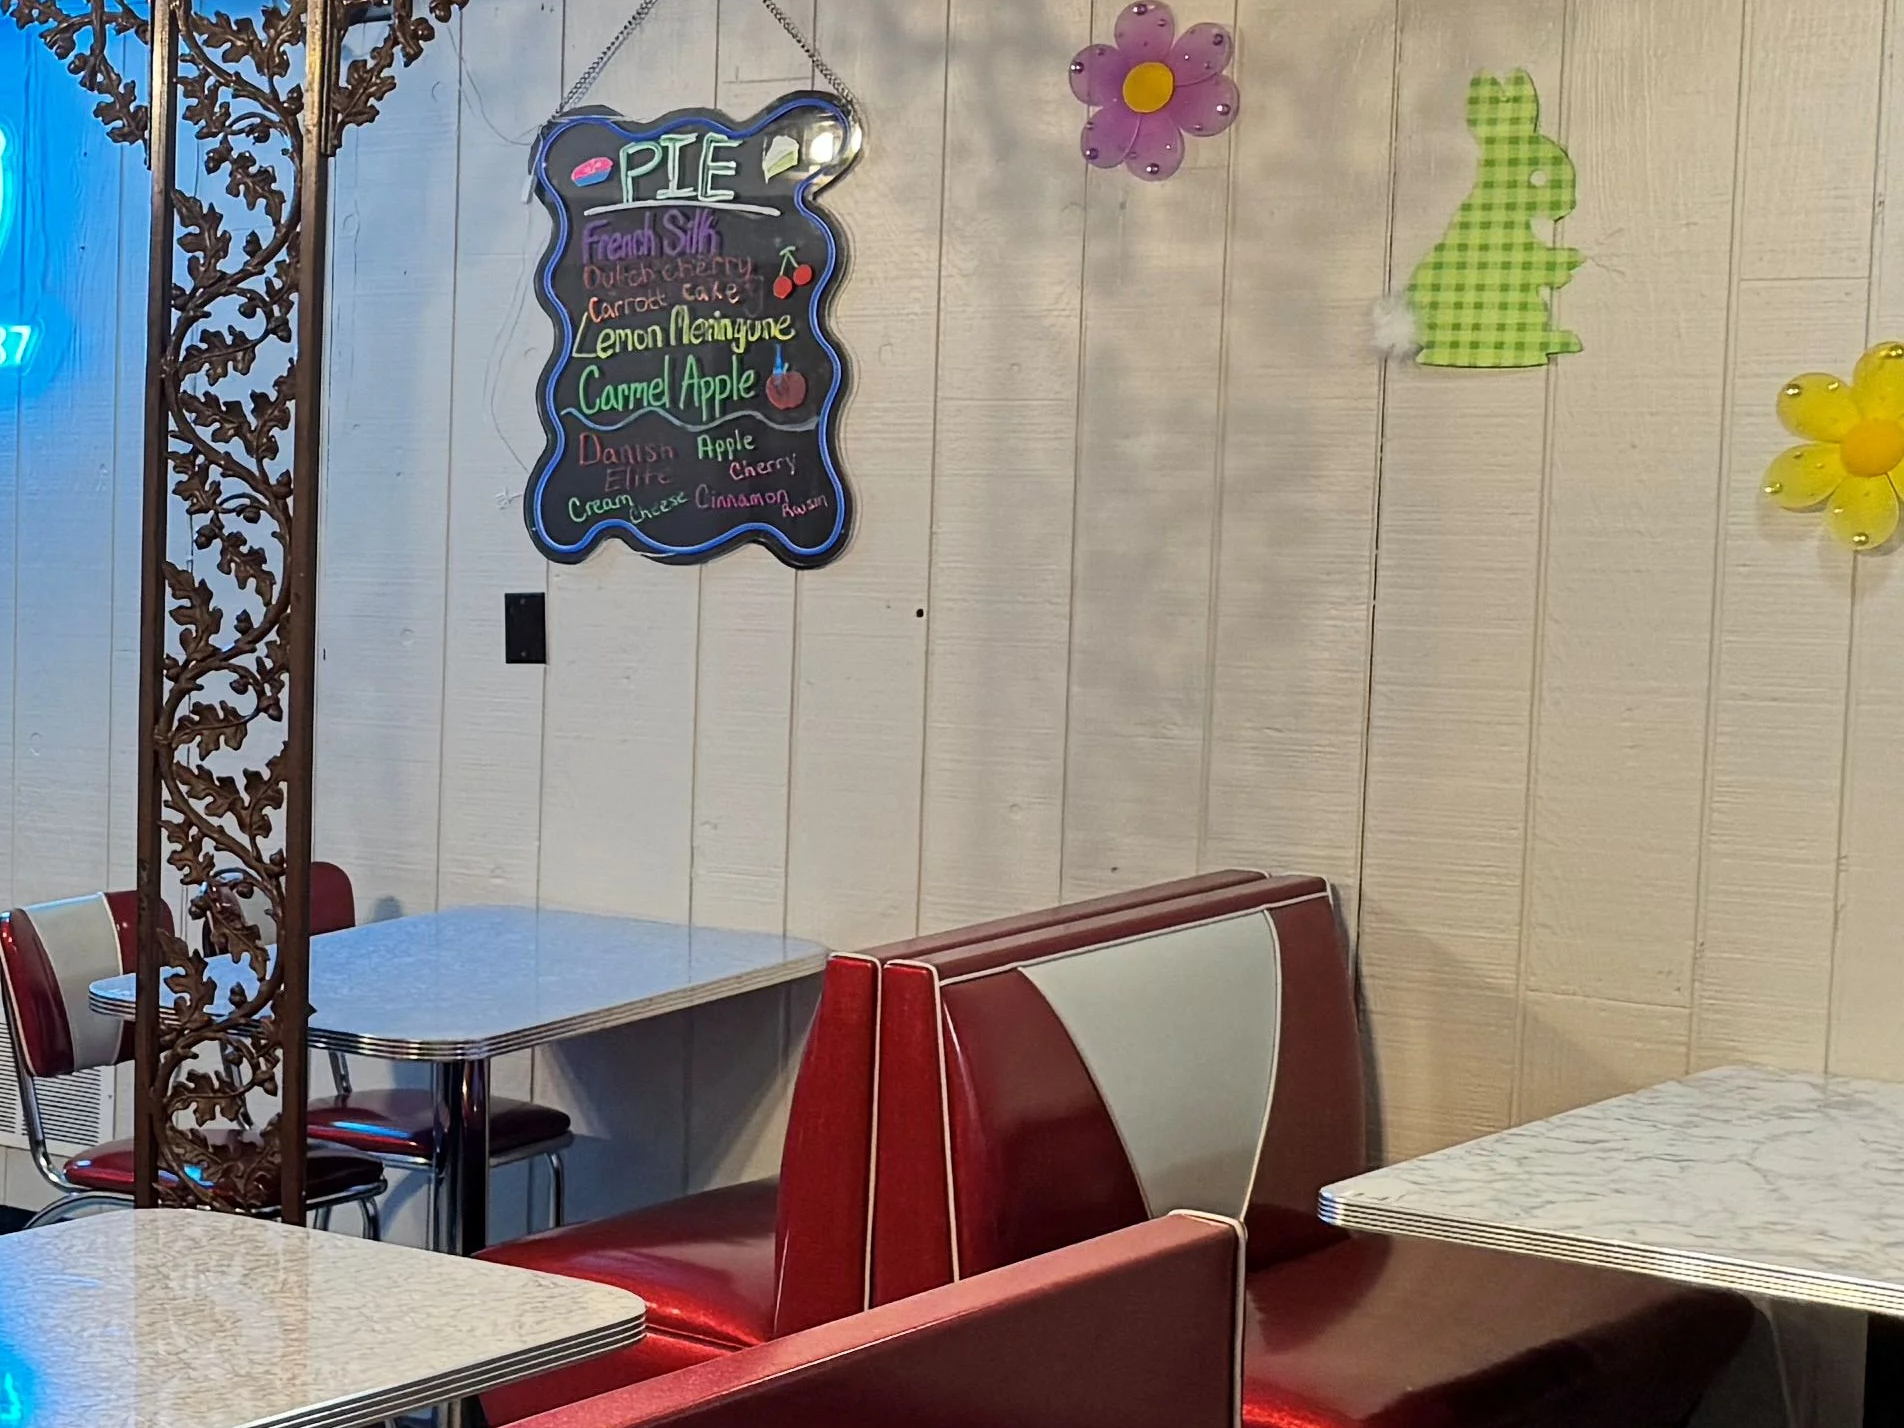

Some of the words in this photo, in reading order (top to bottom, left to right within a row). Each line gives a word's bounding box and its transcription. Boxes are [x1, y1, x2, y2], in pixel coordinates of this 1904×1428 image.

[619, 133, 744, 203] PIE
[582, 211, 656, 264] French
[662, 208, 720, 256] Silk
[572, 310, 663, 358] Lemon
[578, 361, 670, 415] Carmel
[680, 355, 756, 422] Apple
[579, 432, 676, 466] Danish
[696, 429, 756, 461] Apple
[729, 453, 797, 481] Cherry
[568, 493, 634, 523] Cream
[629, 491, 688, 524] Cheese
[695, 483, 790, 510] Cinnamon
